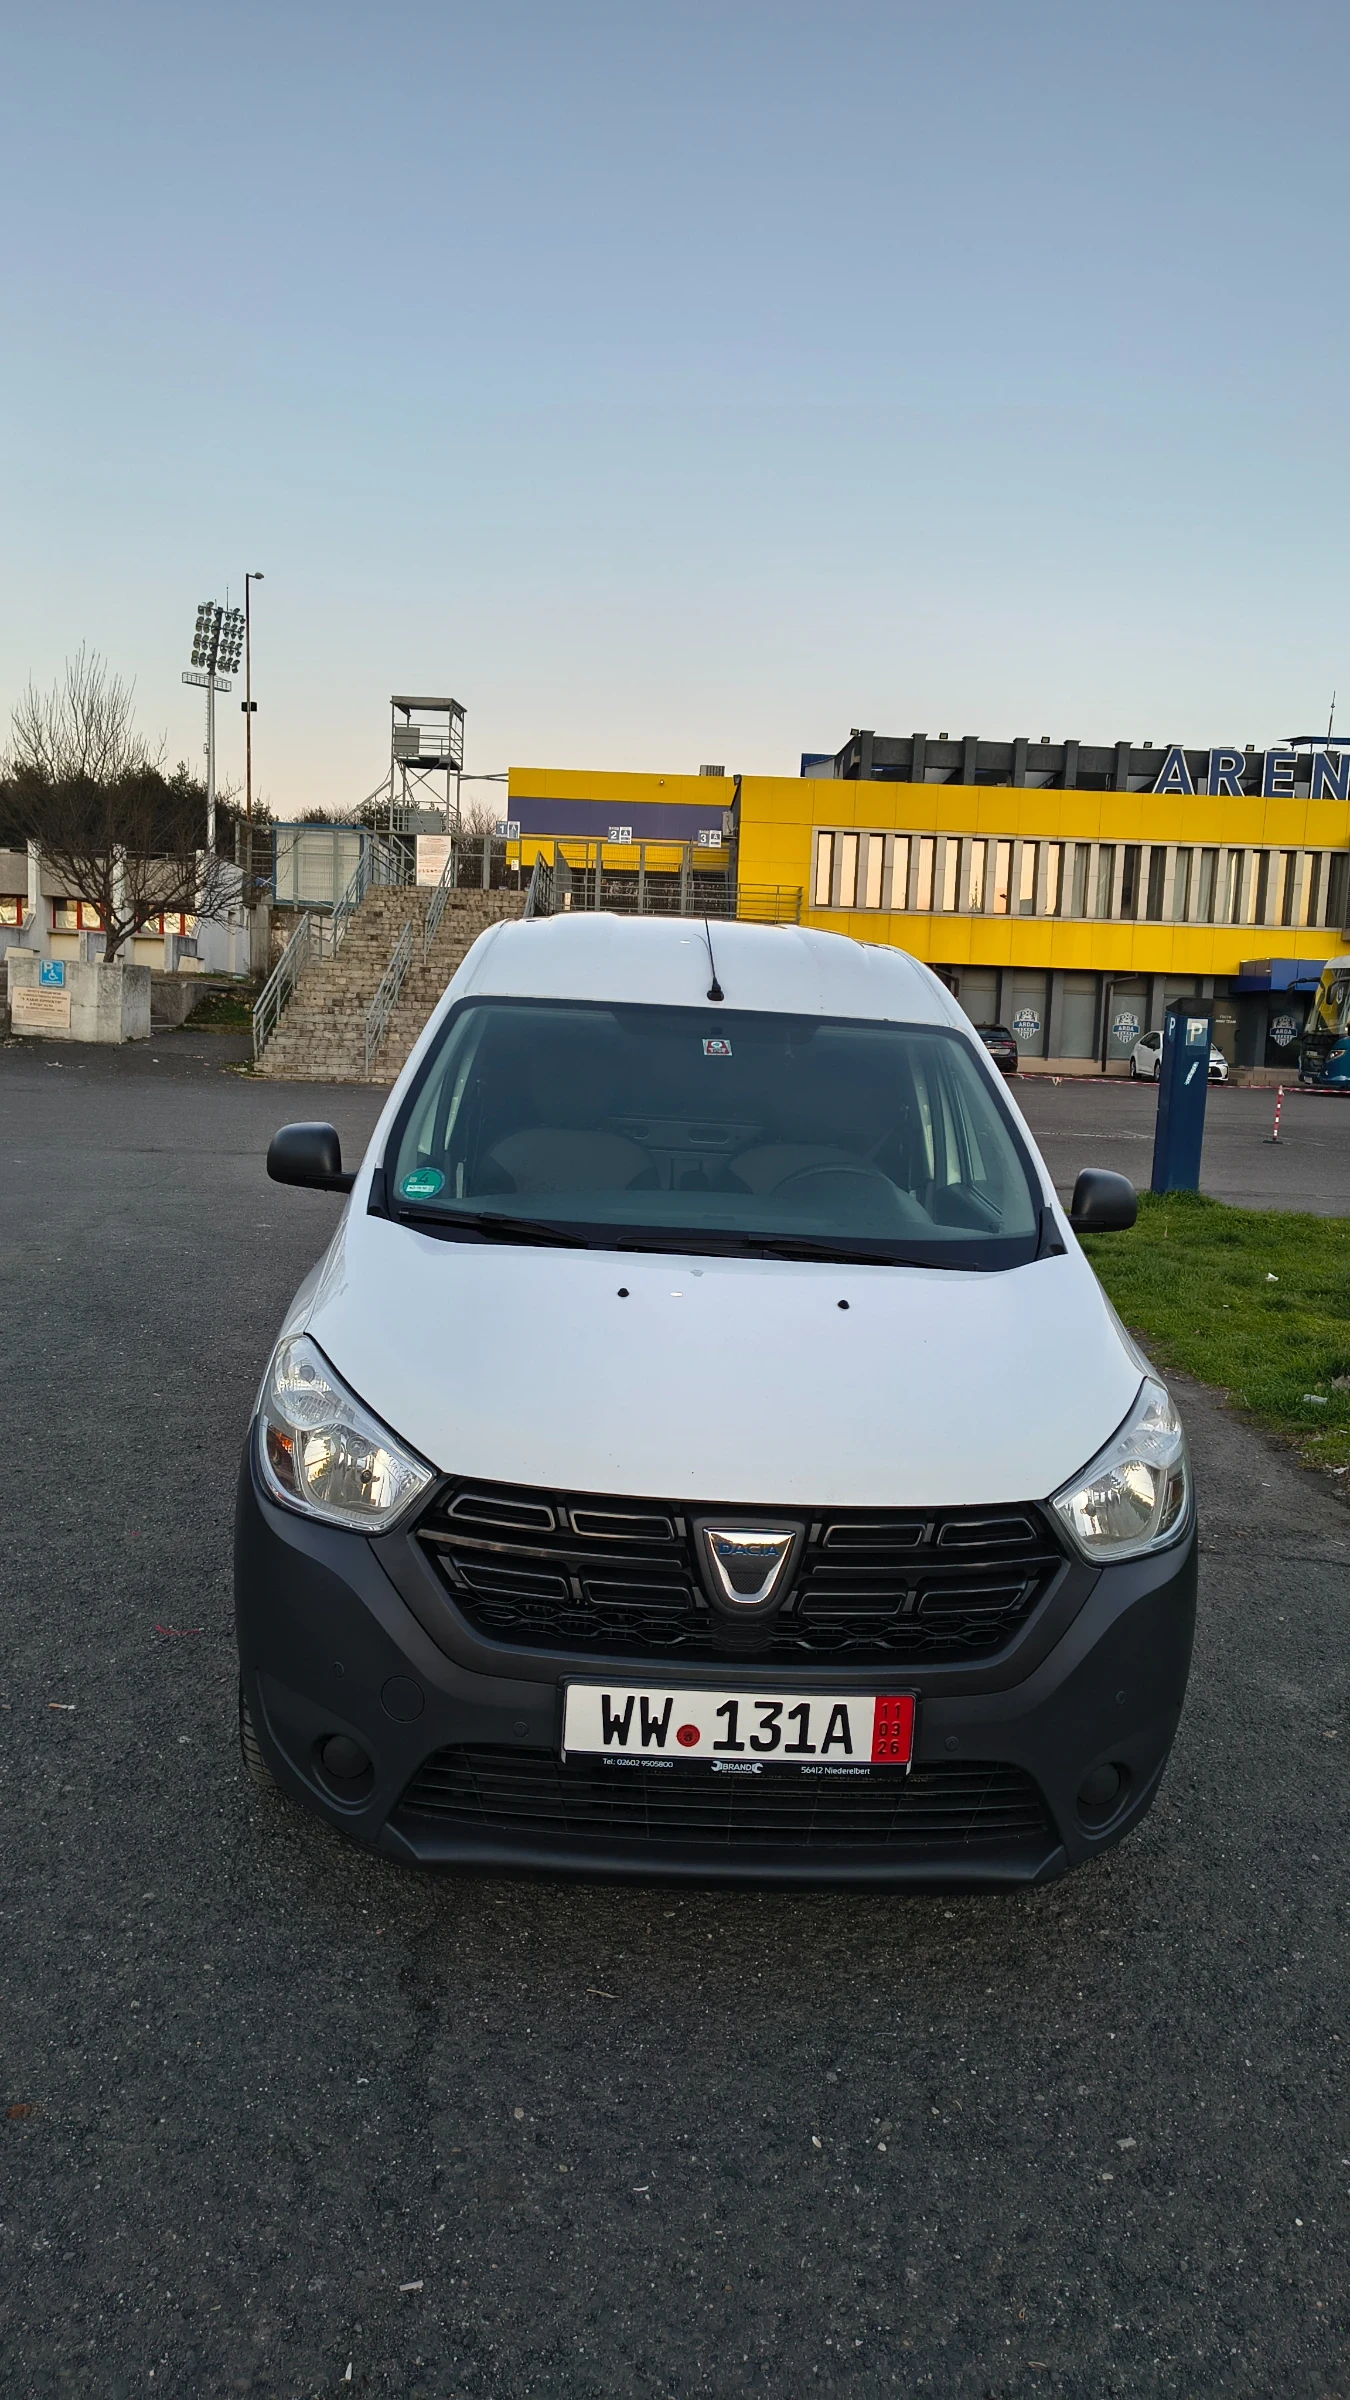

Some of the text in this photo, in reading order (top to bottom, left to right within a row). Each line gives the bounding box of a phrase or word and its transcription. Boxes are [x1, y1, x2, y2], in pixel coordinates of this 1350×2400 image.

[610, 830, 617, 840] 2
[700, 834, 707, 843] 3
[43, 961, 54, 973] P
[1168, 1017, 1176, 1036] P
[1190, 1022, 1203, 1042] P
[418, 1171, 429, 1184] 4
[718, 1543, 780, 1557] DACIA
[882, 1702, 901, 1719] 11
[601, 1694, 853, 1755] WW 131A
[879, 1720, 901, 1737] 03
[877, 1738, 900, 1755] 26
[616, 1758, 640, 1767] 02602
[641, 1760, 674, 1768] 9505800
[801, 1766, 824, 1774] 56412
